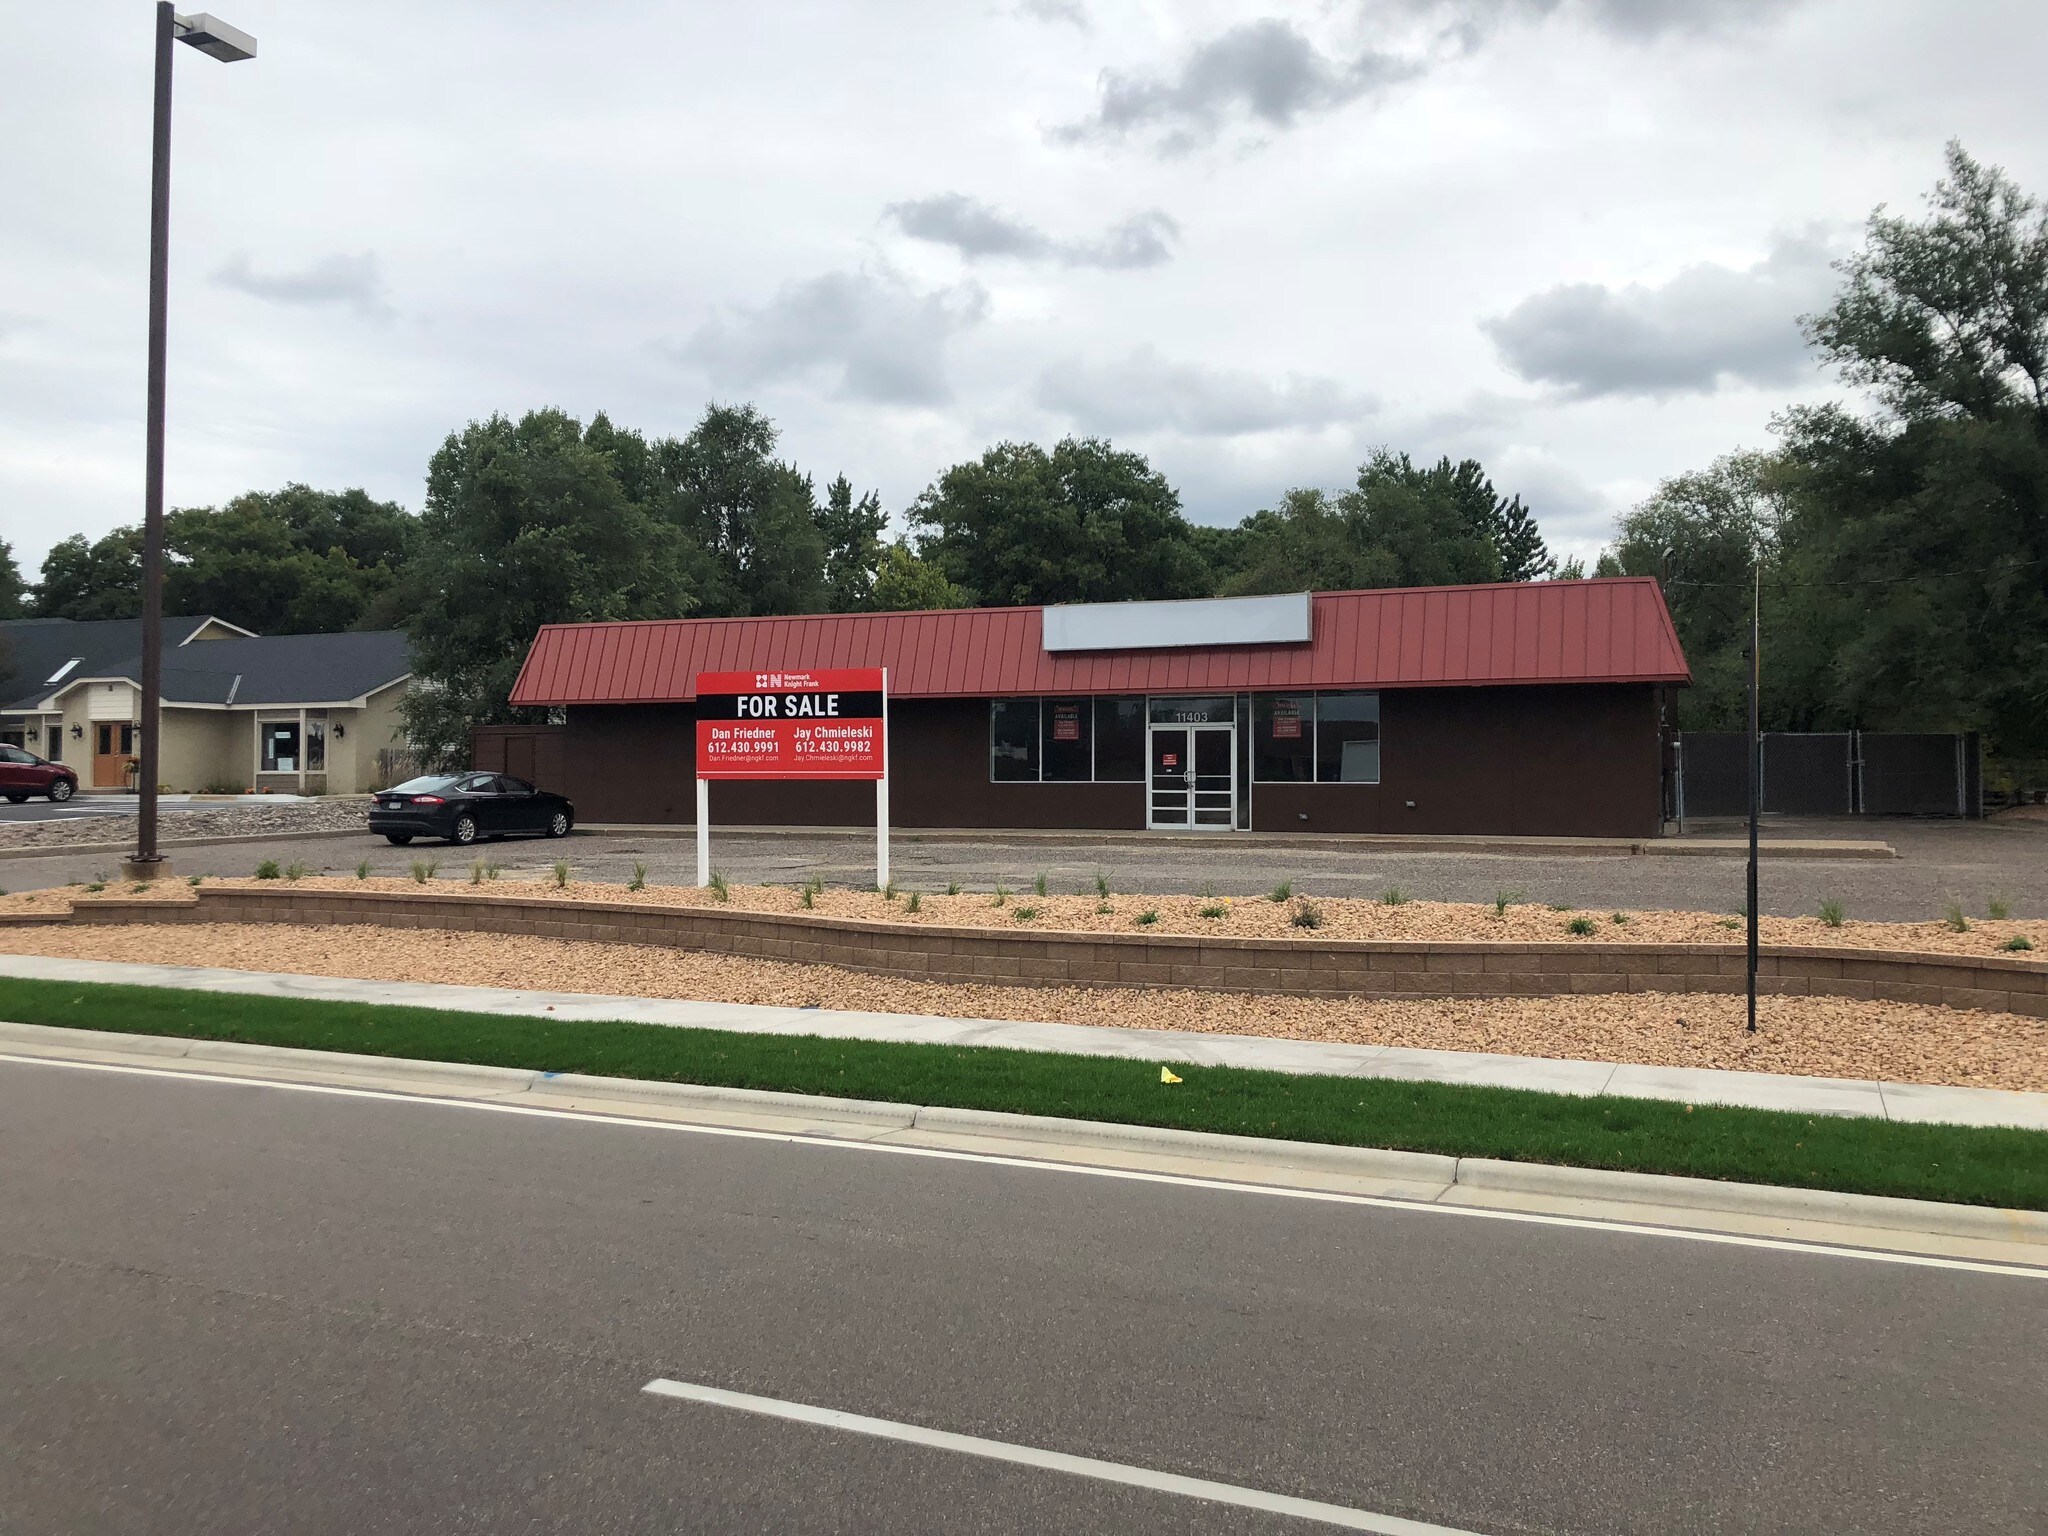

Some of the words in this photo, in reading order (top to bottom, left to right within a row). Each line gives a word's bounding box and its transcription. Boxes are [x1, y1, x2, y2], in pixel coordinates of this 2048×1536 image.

[737, 696, 777, 717] FOR
[785, 694, 839, 716] SALE
[1176, 712, 1208, 722] 11403
[712, 728, 730, 739] Dan
[733, 727, 775, 739] Friedner
[793, 726, 812, 741] Jay
[815, 726, 873, 738] Chmieleski
[708, 741, 779, 753] 612.430.9991
[795, 740, 871, 753] 612.430.9982
[709, 754, 779, 762] Dan.Friedner@ngkf.com
[793, 754, 873, 762] Jay.Chmieleski@ngkf.com
